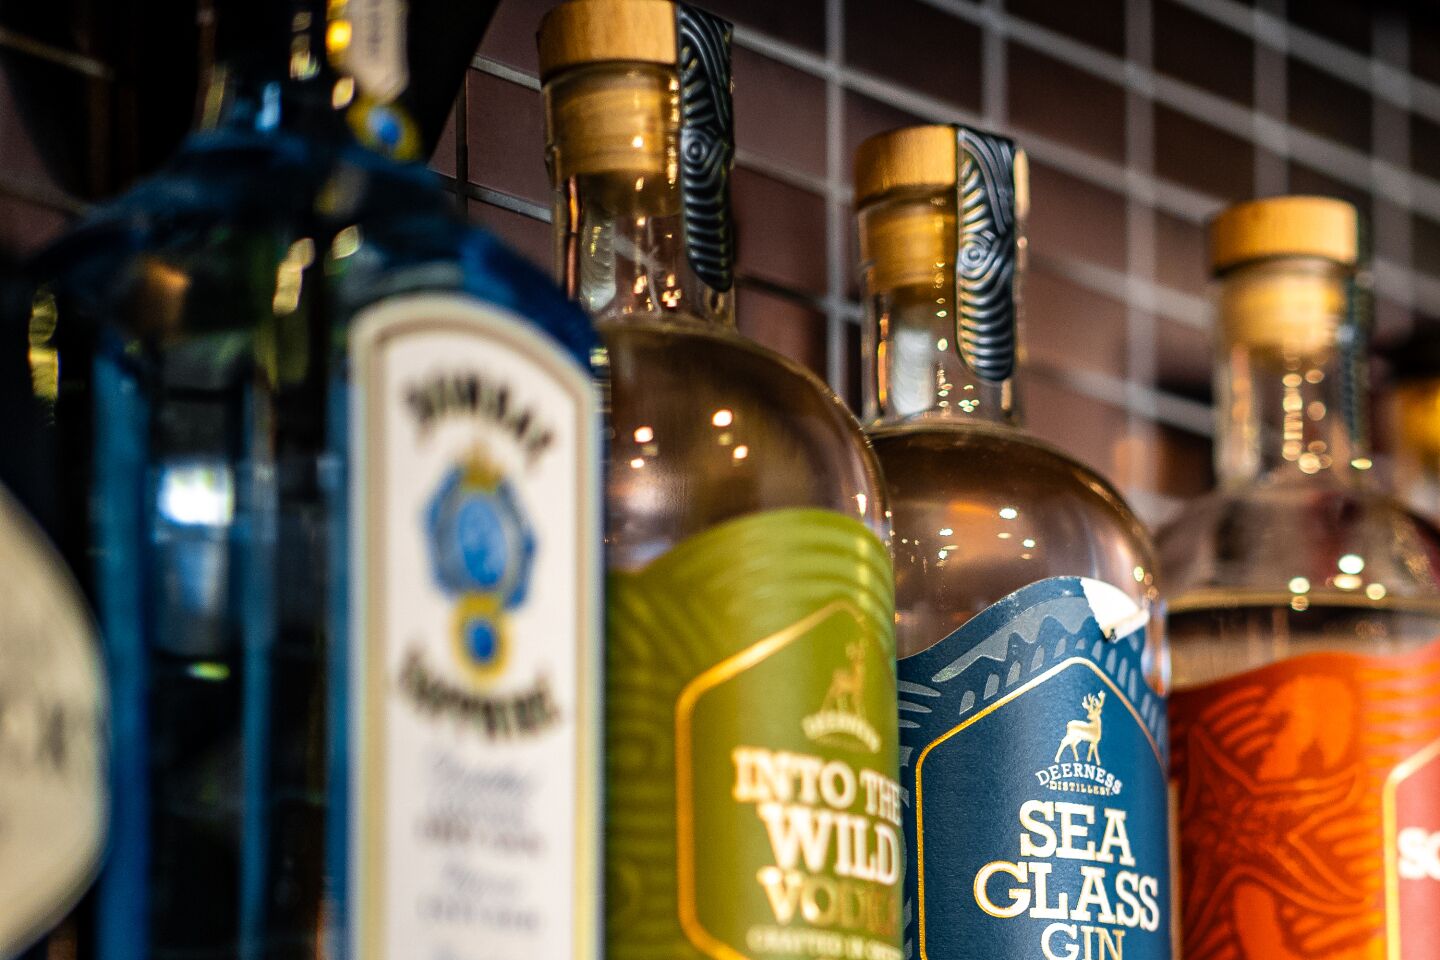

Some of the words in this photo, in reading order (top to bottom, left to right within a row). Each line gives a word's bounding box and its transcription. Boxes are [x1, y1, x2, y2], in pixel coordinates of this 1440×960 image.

[732, 746, 857, 809] INTO
[860, 769, 901, 828] THE
[1035, 763, 1123, 795] DEERNESS
[1049, 780, 1111, 797] DISTILLERY
[757, 802, 900, 888] WILD
[1019, 800, 1136, 867] SEA
[973, 860, 1160, 932] GLASS
